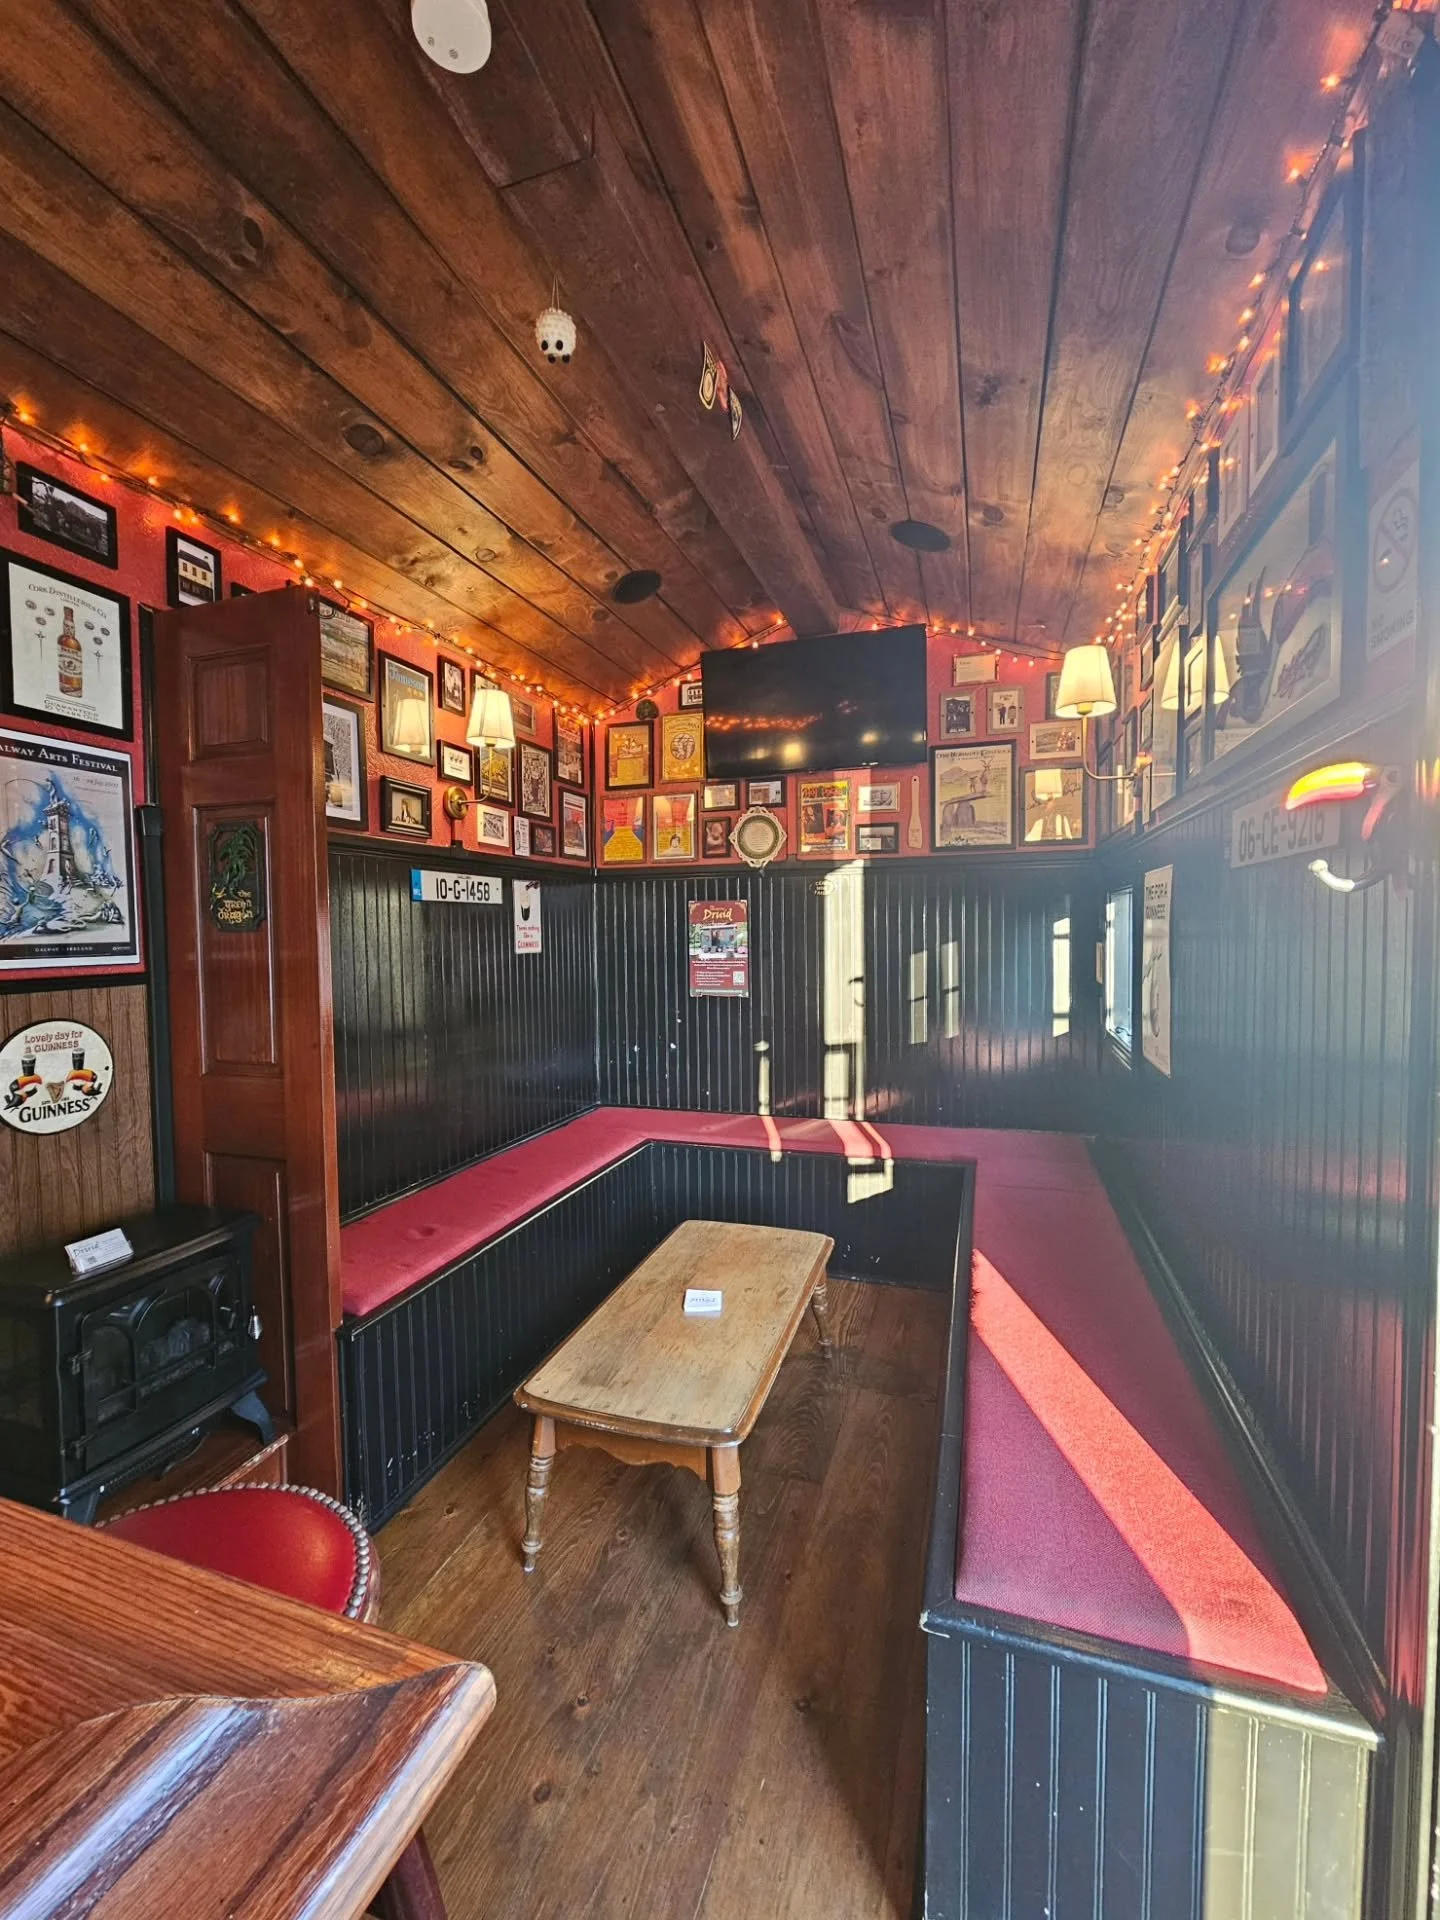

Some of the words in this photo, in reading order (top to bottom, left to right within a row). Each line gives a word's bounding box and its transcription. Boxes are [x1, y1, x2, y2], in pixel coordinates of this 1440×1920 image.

[1369, 609, 1414, 649] SMOKING
[0, 744, 35, 757] ALWAY
[38, 748, 68, 763] ARTS
[72, 753, 118, 772] FESTIVAL
[436, 877, 490, 901] 10-G-1458
[703, 908, 733, 921] Druid
[25, 1033, 53, 1044] Lovely
[55, 1031, 70, 1042] day
[71, 1030, 83, 1039] for
[25, 1046, 32, 1054] a
[34, 1041, 79, 1053] GUINNESS
[19, 1098, 91, 1123] GUINNESS
